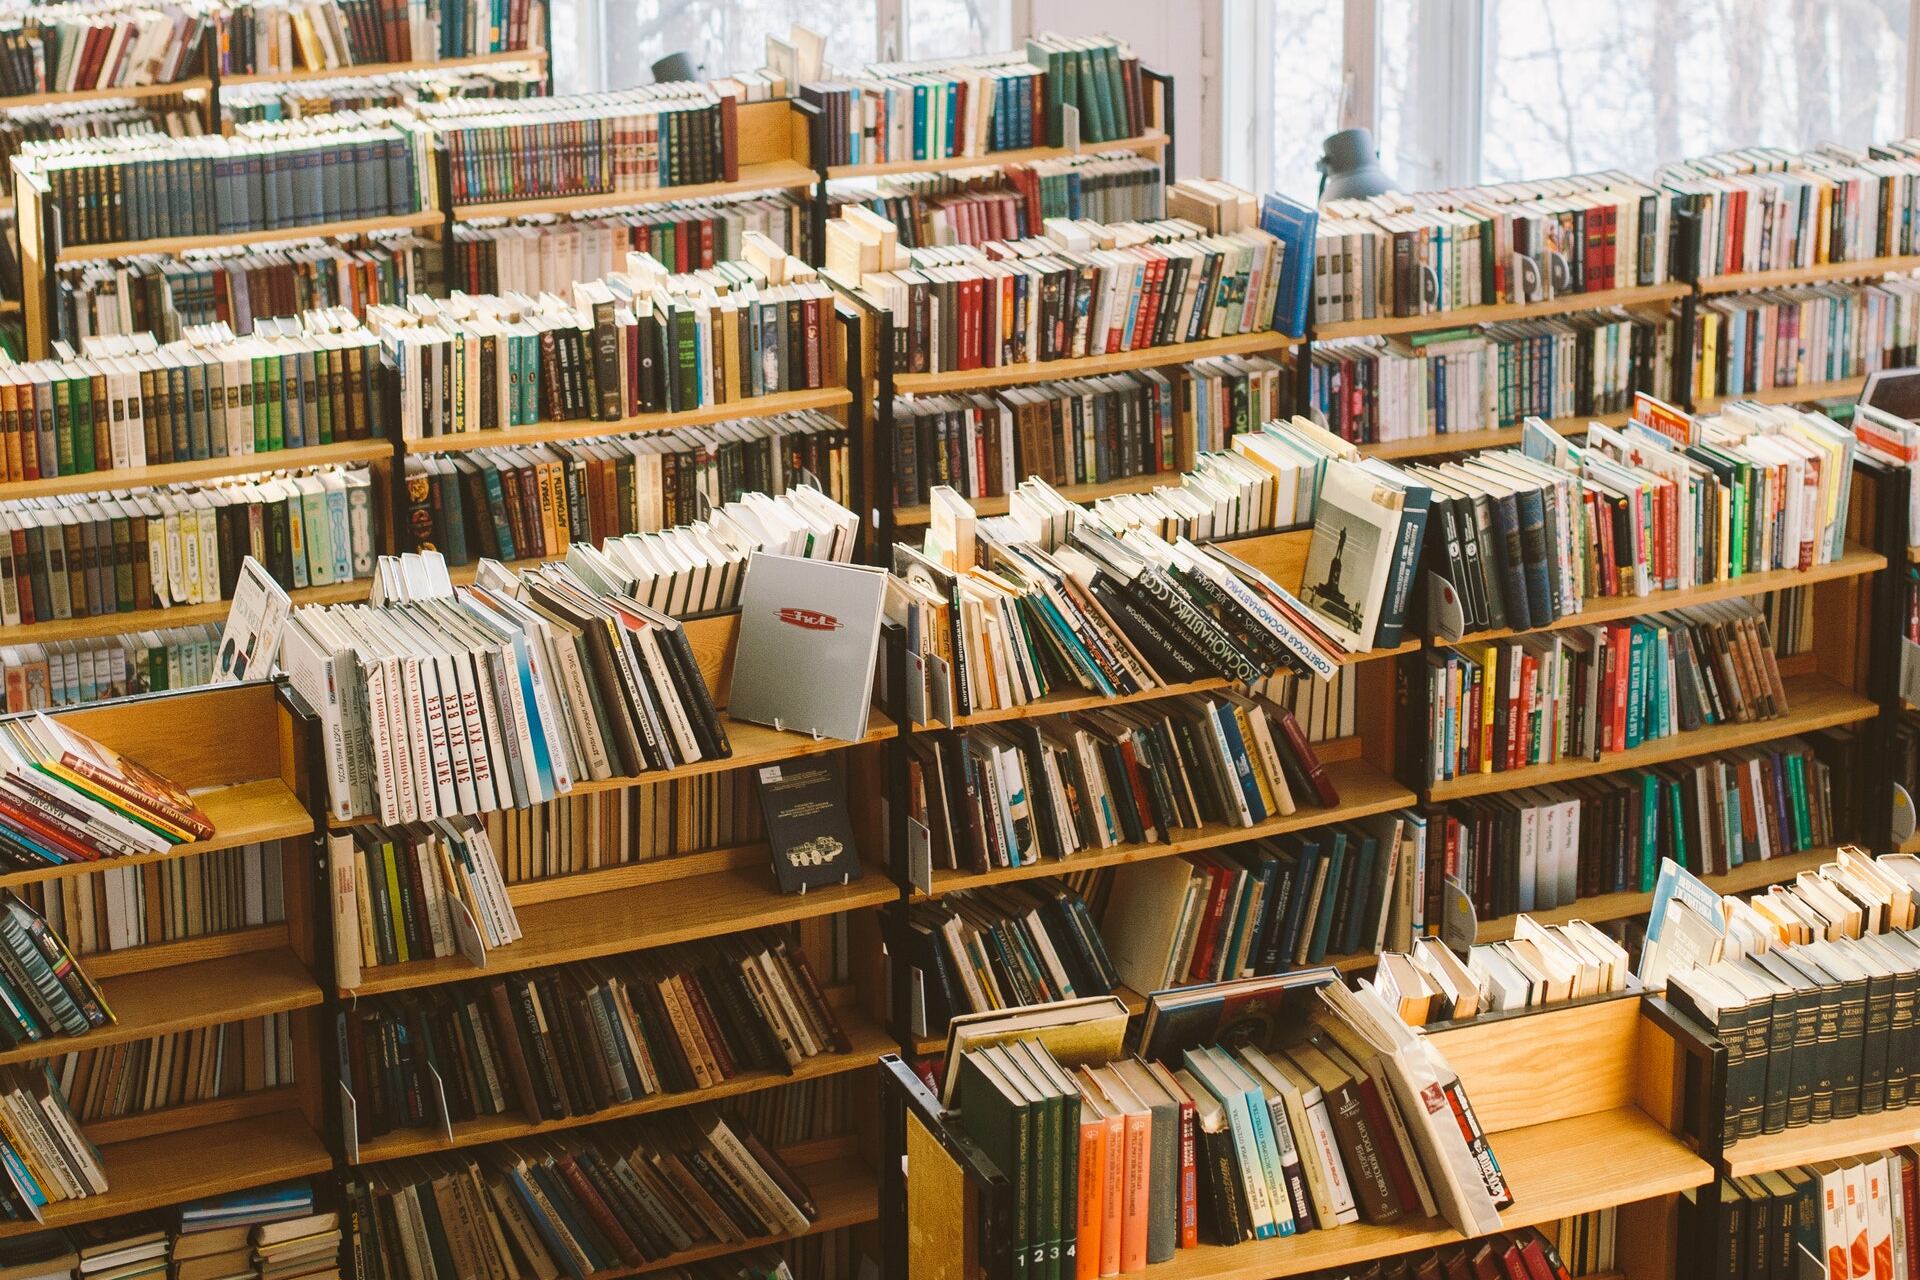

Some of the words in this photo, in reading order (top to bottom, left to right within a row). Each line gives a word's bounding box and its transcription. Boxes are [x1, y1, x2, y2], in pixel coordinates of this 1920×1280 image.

[540, 479, 550, 511] ГЕРАКЛ
[553, 476, 566, 527] АРГОНАВТЫ
[1137, 570, 1170, 602] СССР
[1194, 572, 1228, 605] ЗВЕЗДАМ
[1222, 574, 1289, 639] КОСМОНАВТИКА
[1124, 604, 1163, 642] КОСМОДРОМ
[954, 619, 964, 662] АВТОМОБИЛИ
[1161, 639, 1172, 651] НА
[1166, 596, 1257, 684] КОСМОНАВТИКА
[1288, 633, 1330, 675] СОВЕТСКАЯ
[567, 653, 576, 669] ЗИЛ
[1171, 649, 1195, 673] ДОРОГА
[408, 660, 418, 692] СЛАВЫ
[959, 664, 968, 706] СПОРТИВНЫЕ
[393, 693, 405, 742] ТРУДОВОЙ
[427, 694, 441, 720] ВЕК
[445, 694, 459, 719] ВЕК
[462, 691, 477, 716] ВЕК
[500, 689, 513, 730] ГОРДОСТЬ
[375, 697, 387, 746] ТРУДОВОЙ
[411, 694, 424, 742] ТРУДОВОЙ
[518, 714, 528, 740] НАША
[1508, 705, 1517, 740] ДИКУЛЬ
[507, 732, 517, 758] НАША
[381, 750, 393, 799] СТРАНИЦЫ
[399, 742, 411, 796] СТРАНИЦЫ
[418, 745, 431, 796] СТРАНИЦЫ
[436, 760, 450, 785] ЗИЛ
[455, 758, 470, 783] ЗИЛ
[473, 755, 488, 780] ЗИЛ
[27, 791, 66, 819] МАКРАМЕ
[387, 804, 395, 820] ЗИЛ
[424, 801, 432, 816] ЗИЛ
[1820, 1012, 1838, 1021] ЛЕНИН
[1842, 1007, 1864, 1016] ЛЕНИН
[1895, 999, 1914, 1008] ЛЕНИН
[1746, 1026, 1767, 1036] ЛЕНИН
[1341, 1088, 1350, 1104] 1
[1358, 1118, 1374, 1152] РОССИИ
[1356, 1142, 1372, 1179] ИСТОРИЯ
[1369, 1152, 1389, 1197] СОВЕТСКОЙ
[1018, 1254, 1025, 1267] 1
[1034, 1249, 1044, 1263] 2
[1050, 1246, 1060, 1260] 3
[1066, 1244, 1076, 1257] 4
